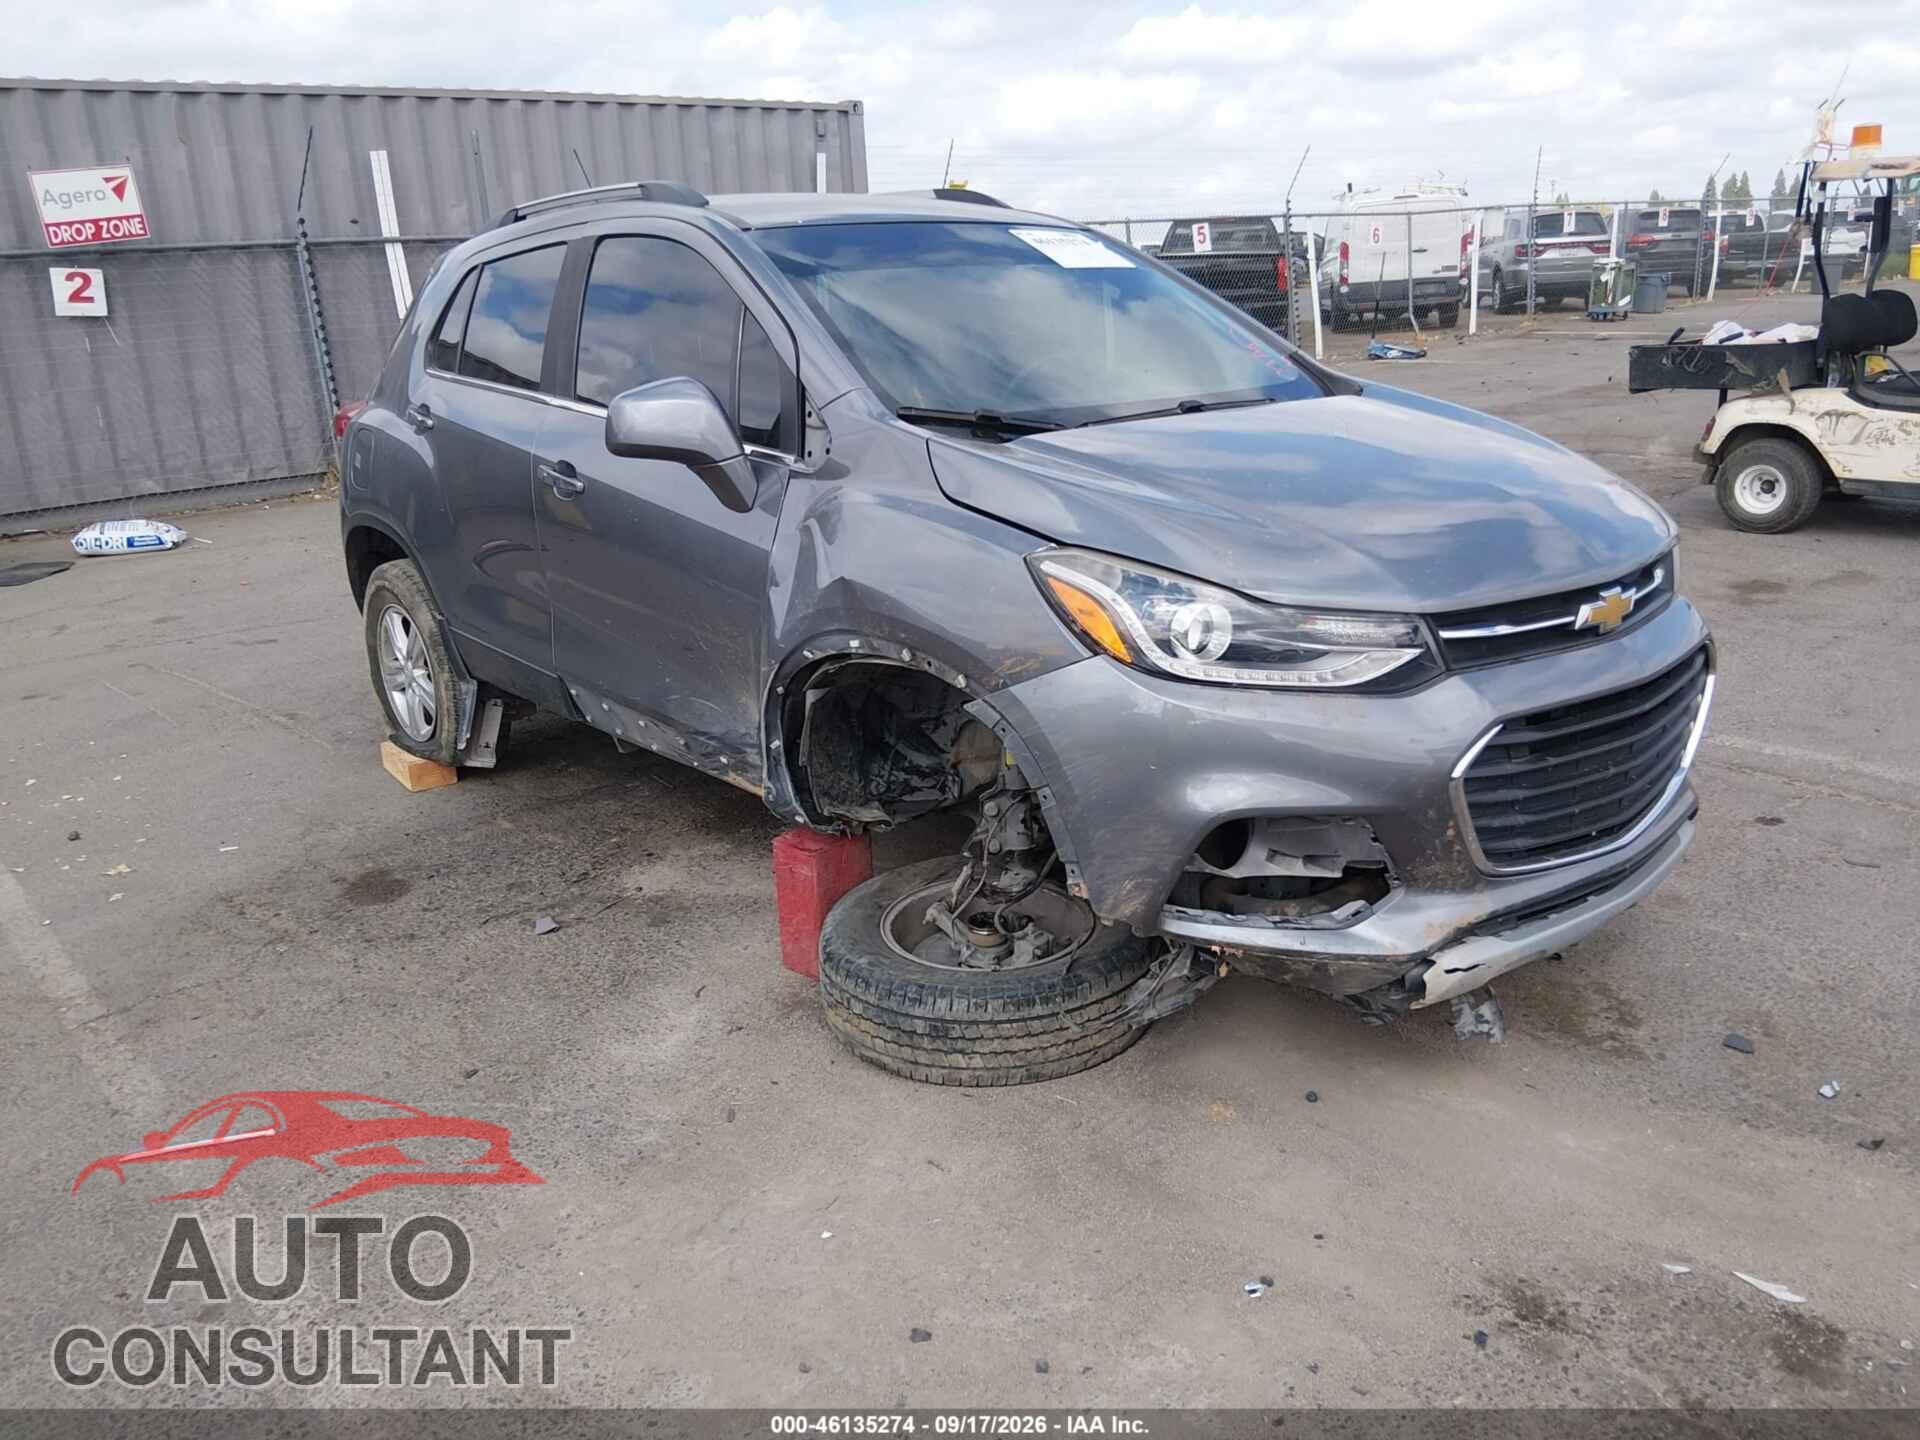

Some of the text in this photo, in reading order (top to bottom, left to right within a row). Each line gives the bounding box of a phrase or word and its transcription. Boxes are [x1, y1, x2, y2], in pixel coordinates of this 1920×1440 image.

[42, 188, 106, 210] Agero
[48, 217, 145, 244] DROP ZONE
[1197, 225, 1207, 245] 5
[1372, 227, 1380, 245] 6
[64, 271, 95, 304] 2
